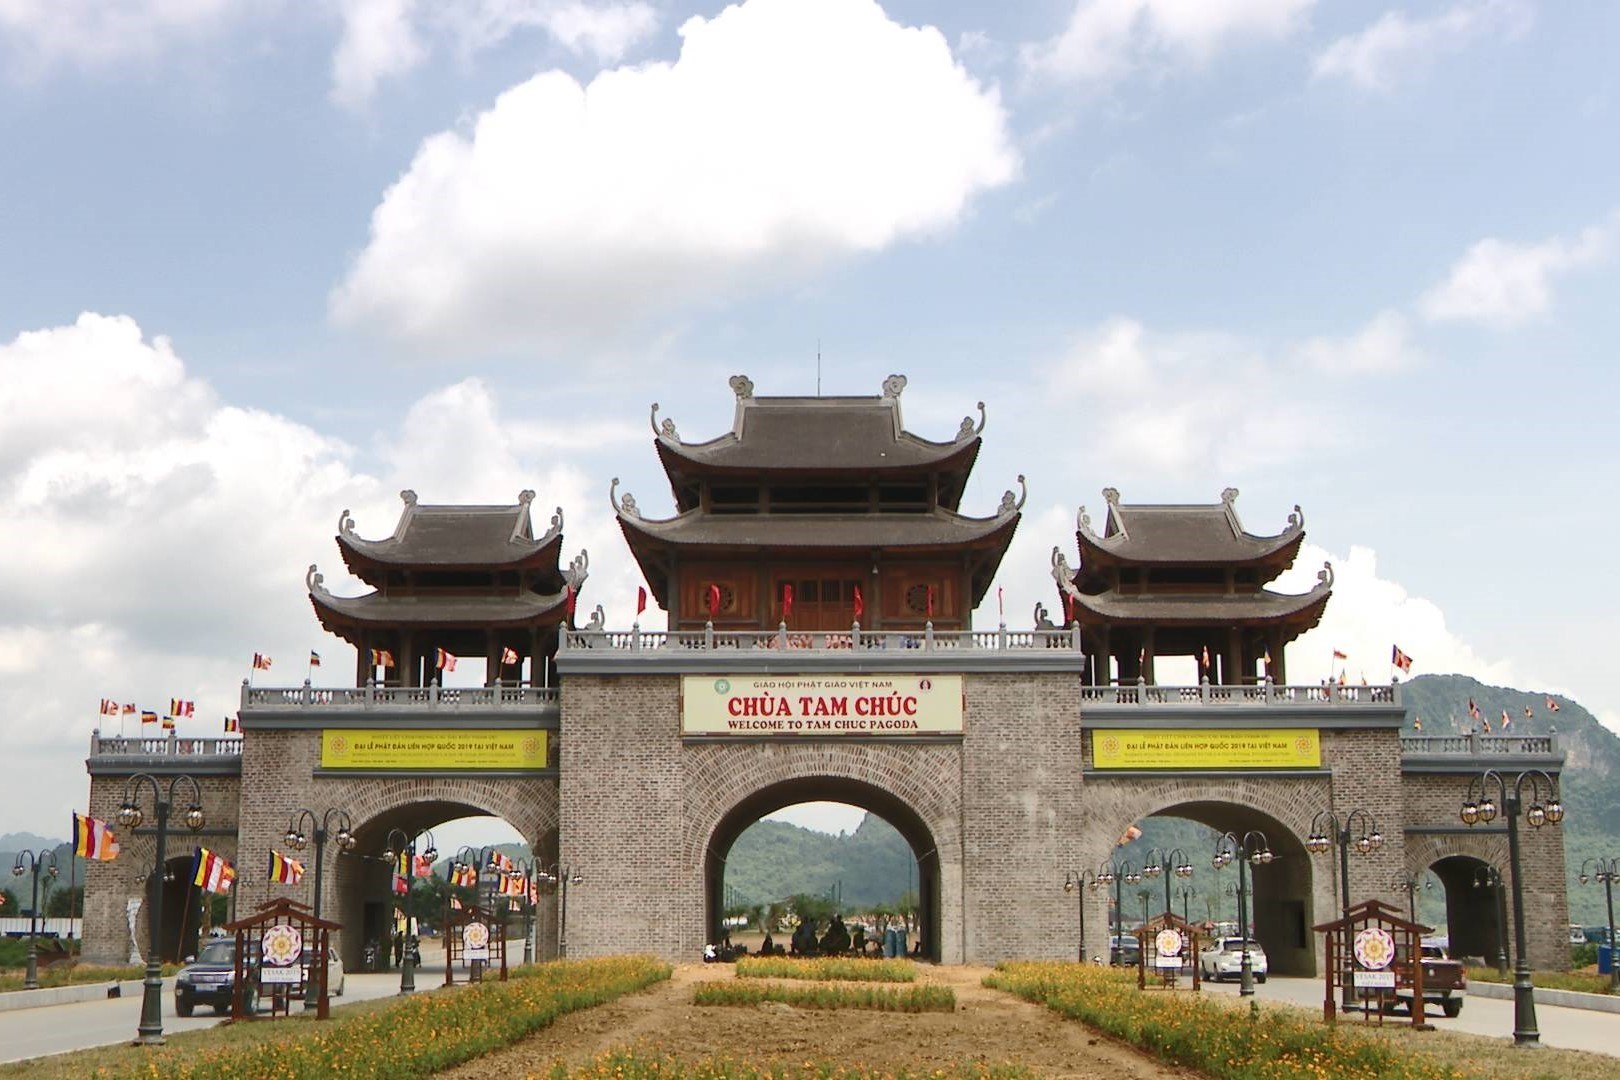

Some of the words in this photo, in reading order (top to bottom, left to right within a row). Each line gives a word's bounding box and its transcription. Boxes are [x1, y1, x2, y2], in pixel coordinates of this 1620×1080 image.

[753, 680, 776, 689] GIÁO
[824, 680, 847, 689] GIÁO
[728, 691, 792, 716] CHÙA
[799, 696, 848, 716] TAM
[855, 690, 917, 716] CHÚC
[728, 720, 784, 729] WELCOME
[787, 720, 803, 729] TO
[806, 720, 831, 729] TAM
[834, 720, 866, 729] CHUC
[869, 720, 918, 729] PAGODA
